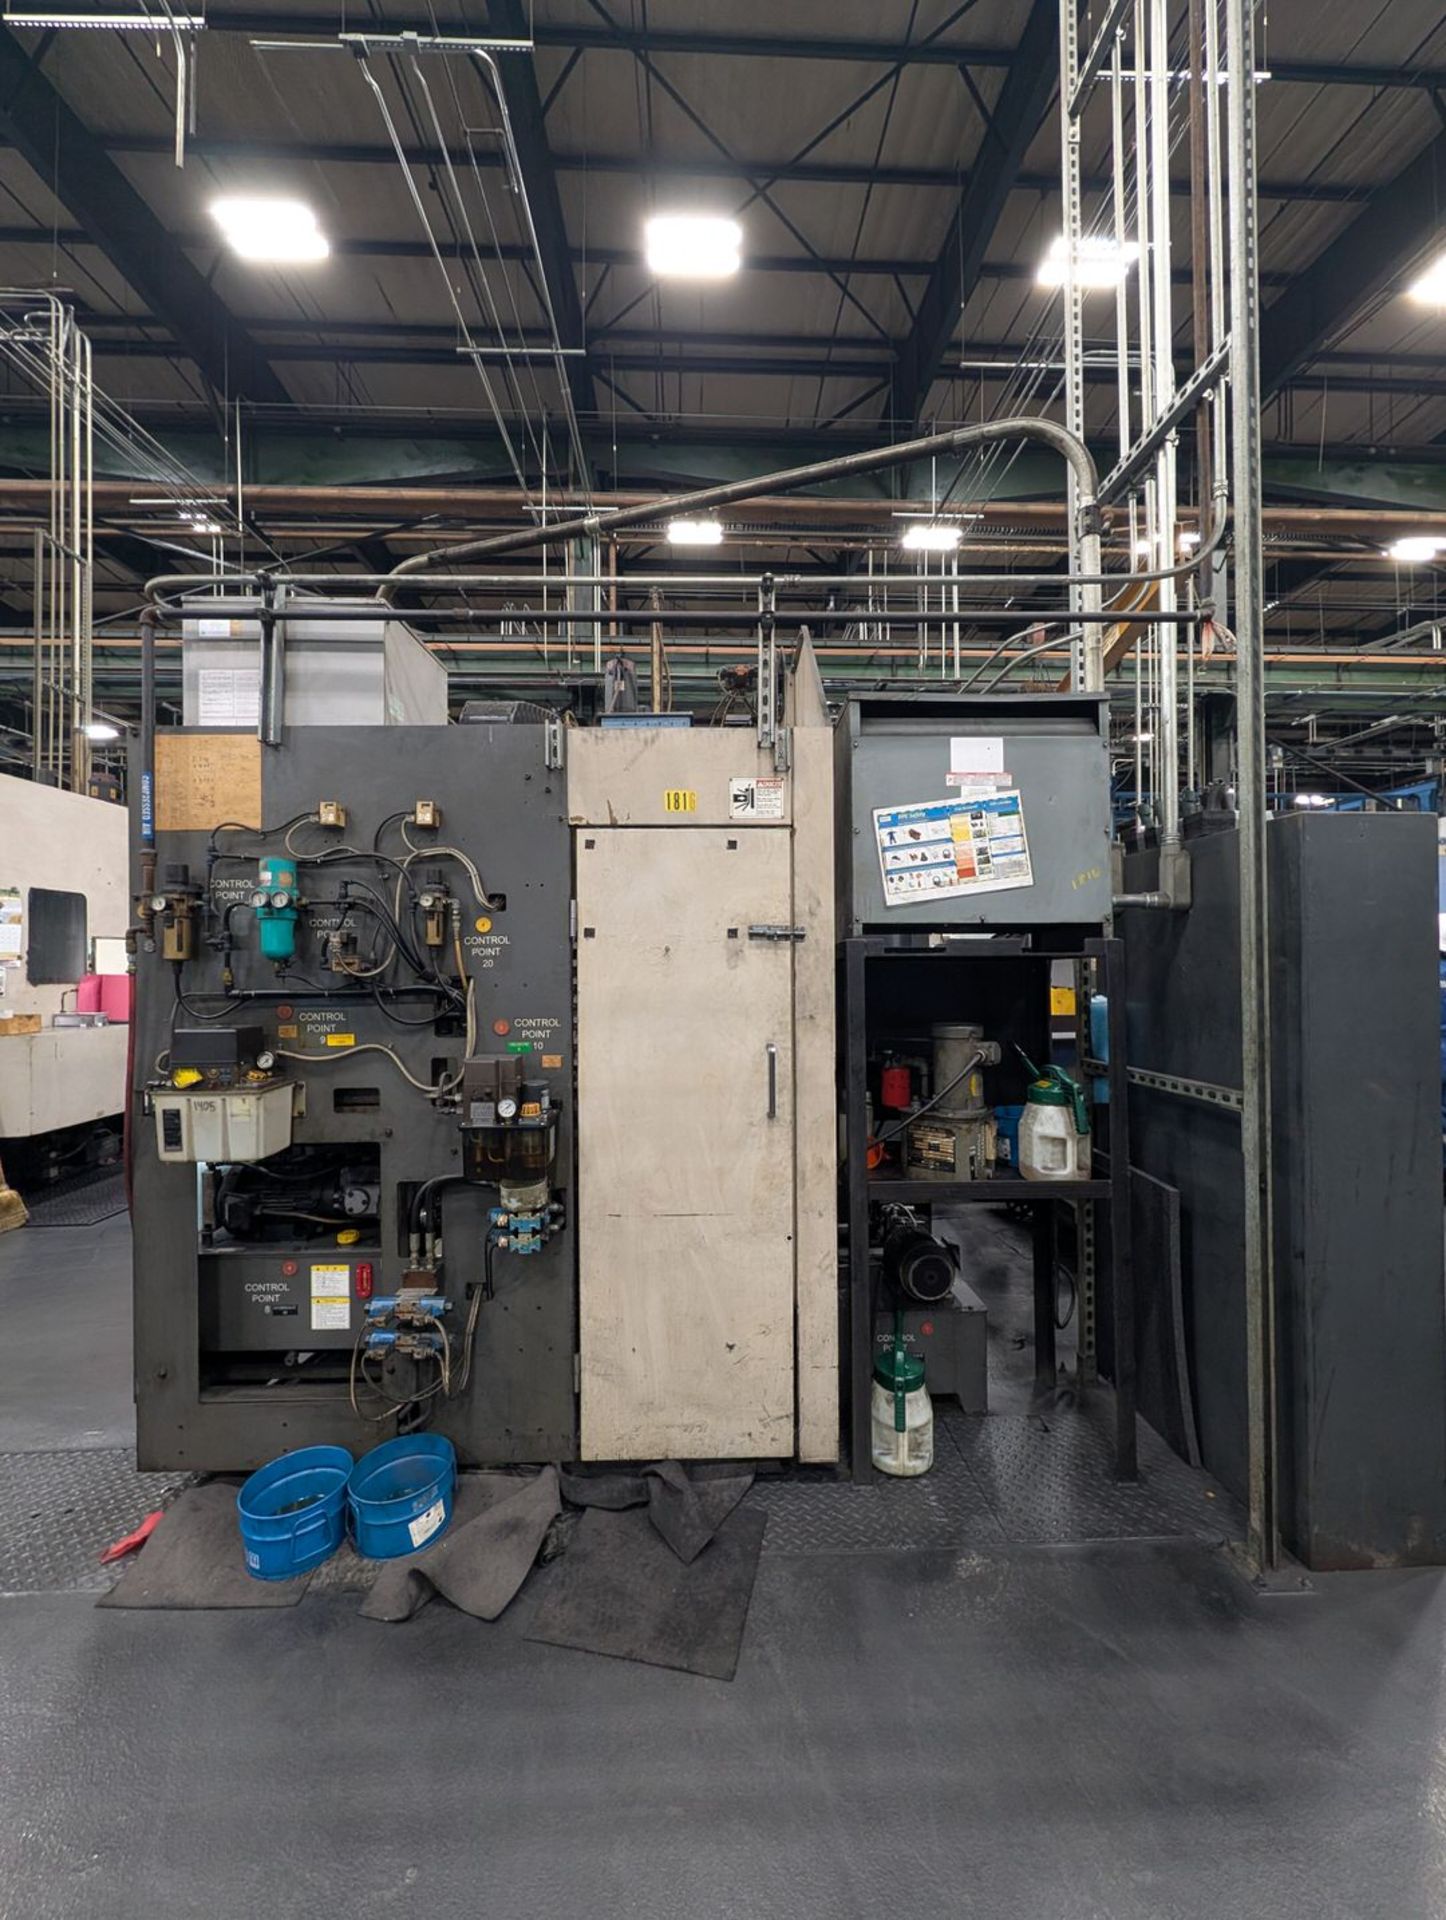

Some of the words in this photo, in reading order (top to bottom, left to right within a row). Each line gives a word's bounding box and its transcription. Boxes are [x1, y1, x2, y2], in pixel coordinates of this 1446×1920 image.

[216, 891, 245, 899] POINT
[464, 935, 511, 944] CONTROL
[472, 947, 501, 956] POINT
[482, 959, 494, 968] 20
[299, 1012, 346, 1021] CONTROL
[514, 1018, 561, 1027] CONTROL
[307, 1024, 336, 1032] POINT
[521, 1030, 551, 1038] POINT
[533, 1042, 544, 1050] 10
[194, 1101, 217, 1112] 1405
[244, 1283, 290, 1292] CONTROL
[252, 1294, 281, 1302] POINT
